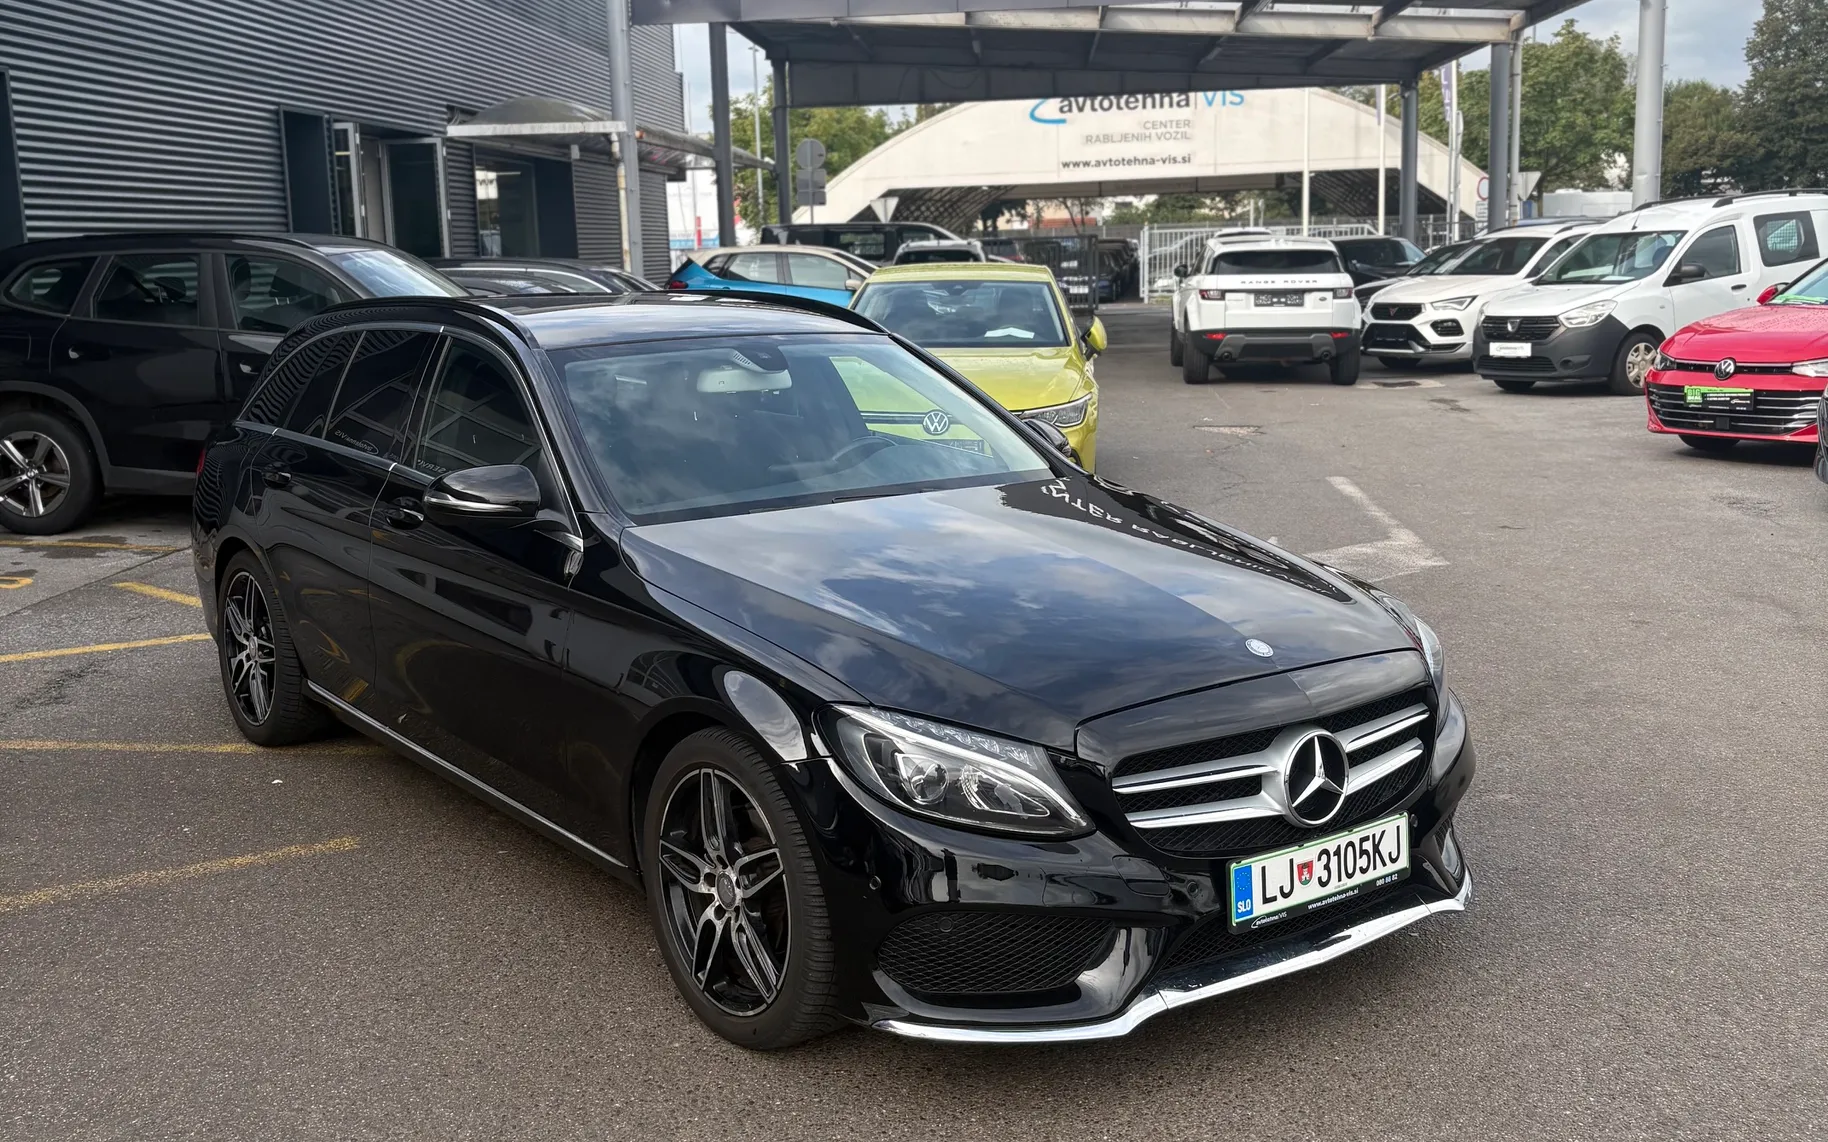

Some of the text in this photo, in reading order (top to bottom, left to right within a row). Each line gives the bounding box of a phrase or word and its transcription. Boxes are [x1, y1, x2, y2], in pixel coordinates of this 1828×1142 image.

[1143, 119, 1191, 130] CENTER
[1085, 131, 1191, 145] RABLJENIH VOZIL
[1061, 154, 1191, 169] www.avtotehna-vis.si
[1261, 825, 1401, 905] LJ 3105KJ
[1307, 887, 1359, 910] www.avtotehna-vis.si
[1237, 899, 1251, 913] SLO
